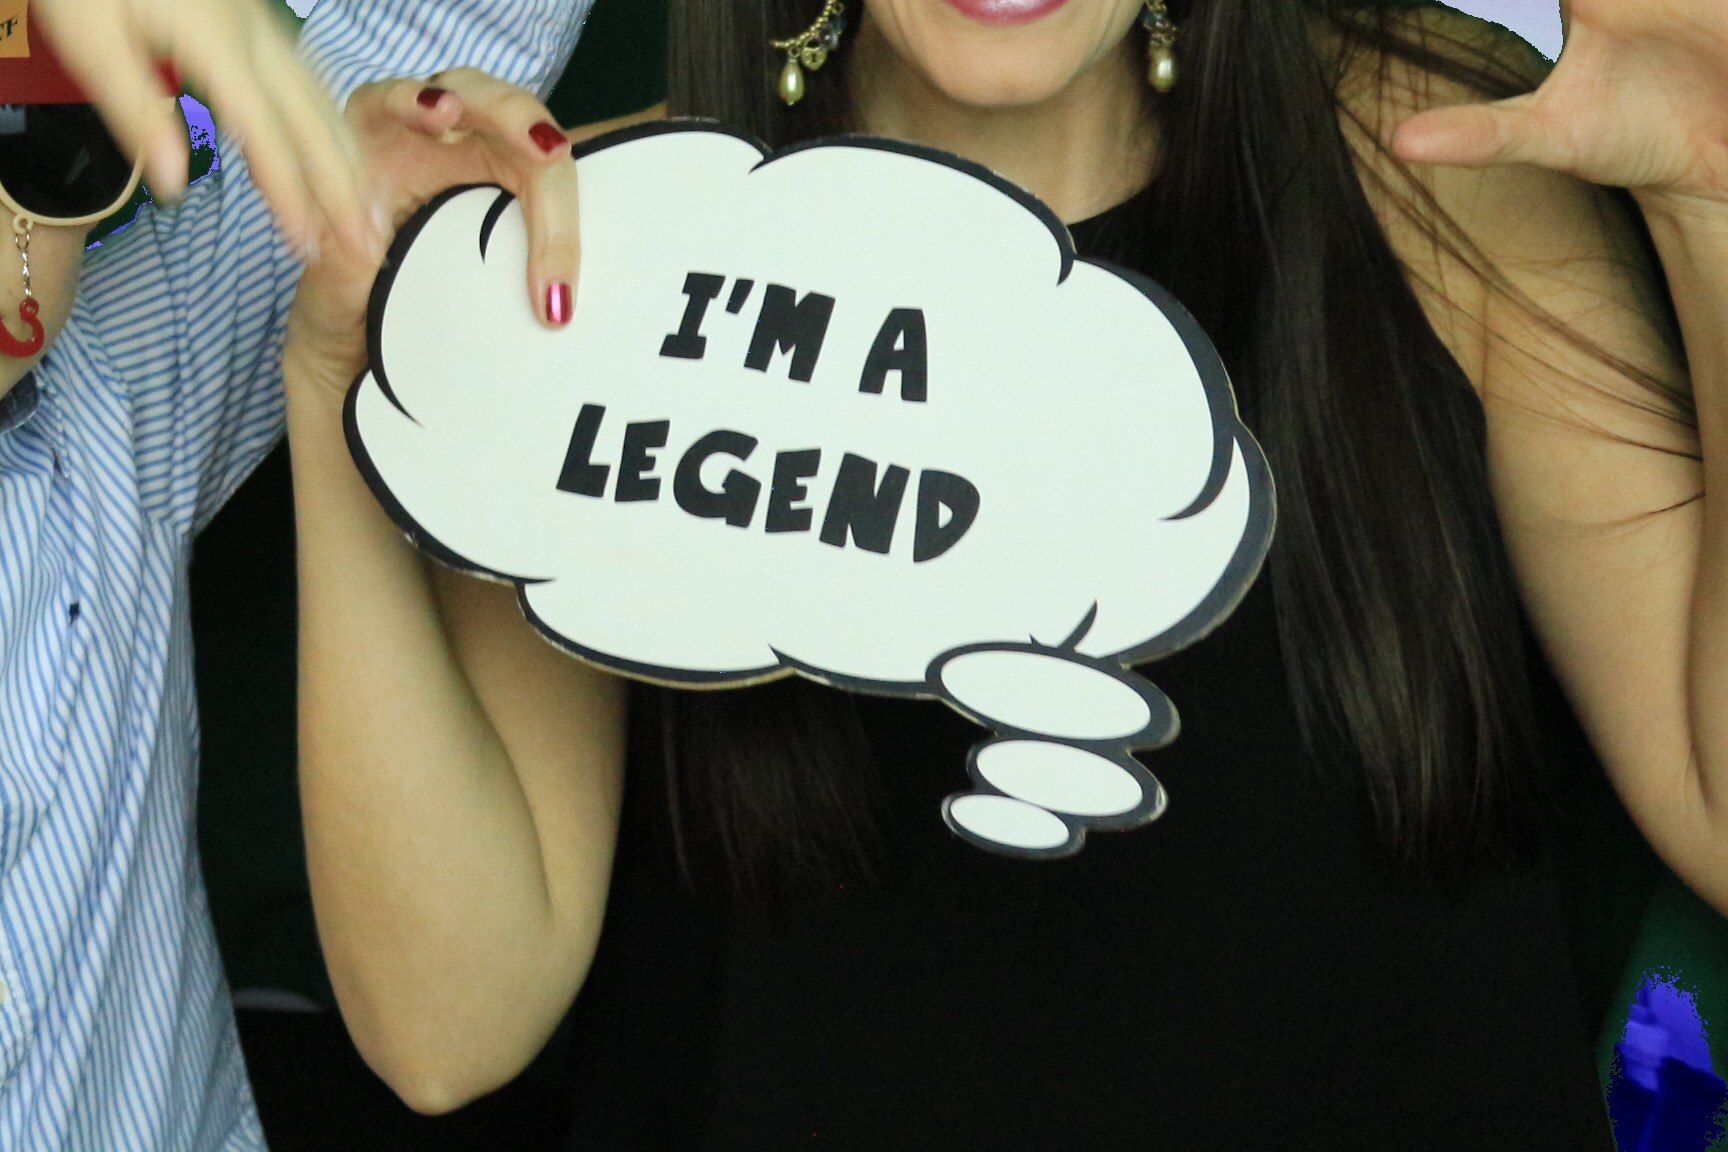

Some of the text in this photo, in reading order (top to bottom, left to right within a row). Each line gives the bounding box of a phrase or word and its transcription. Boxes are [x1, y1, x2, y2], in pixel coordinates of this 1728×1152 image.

[658, 272, 929, 404] I'M A
[555, 403, 981, 564] LEGEND
